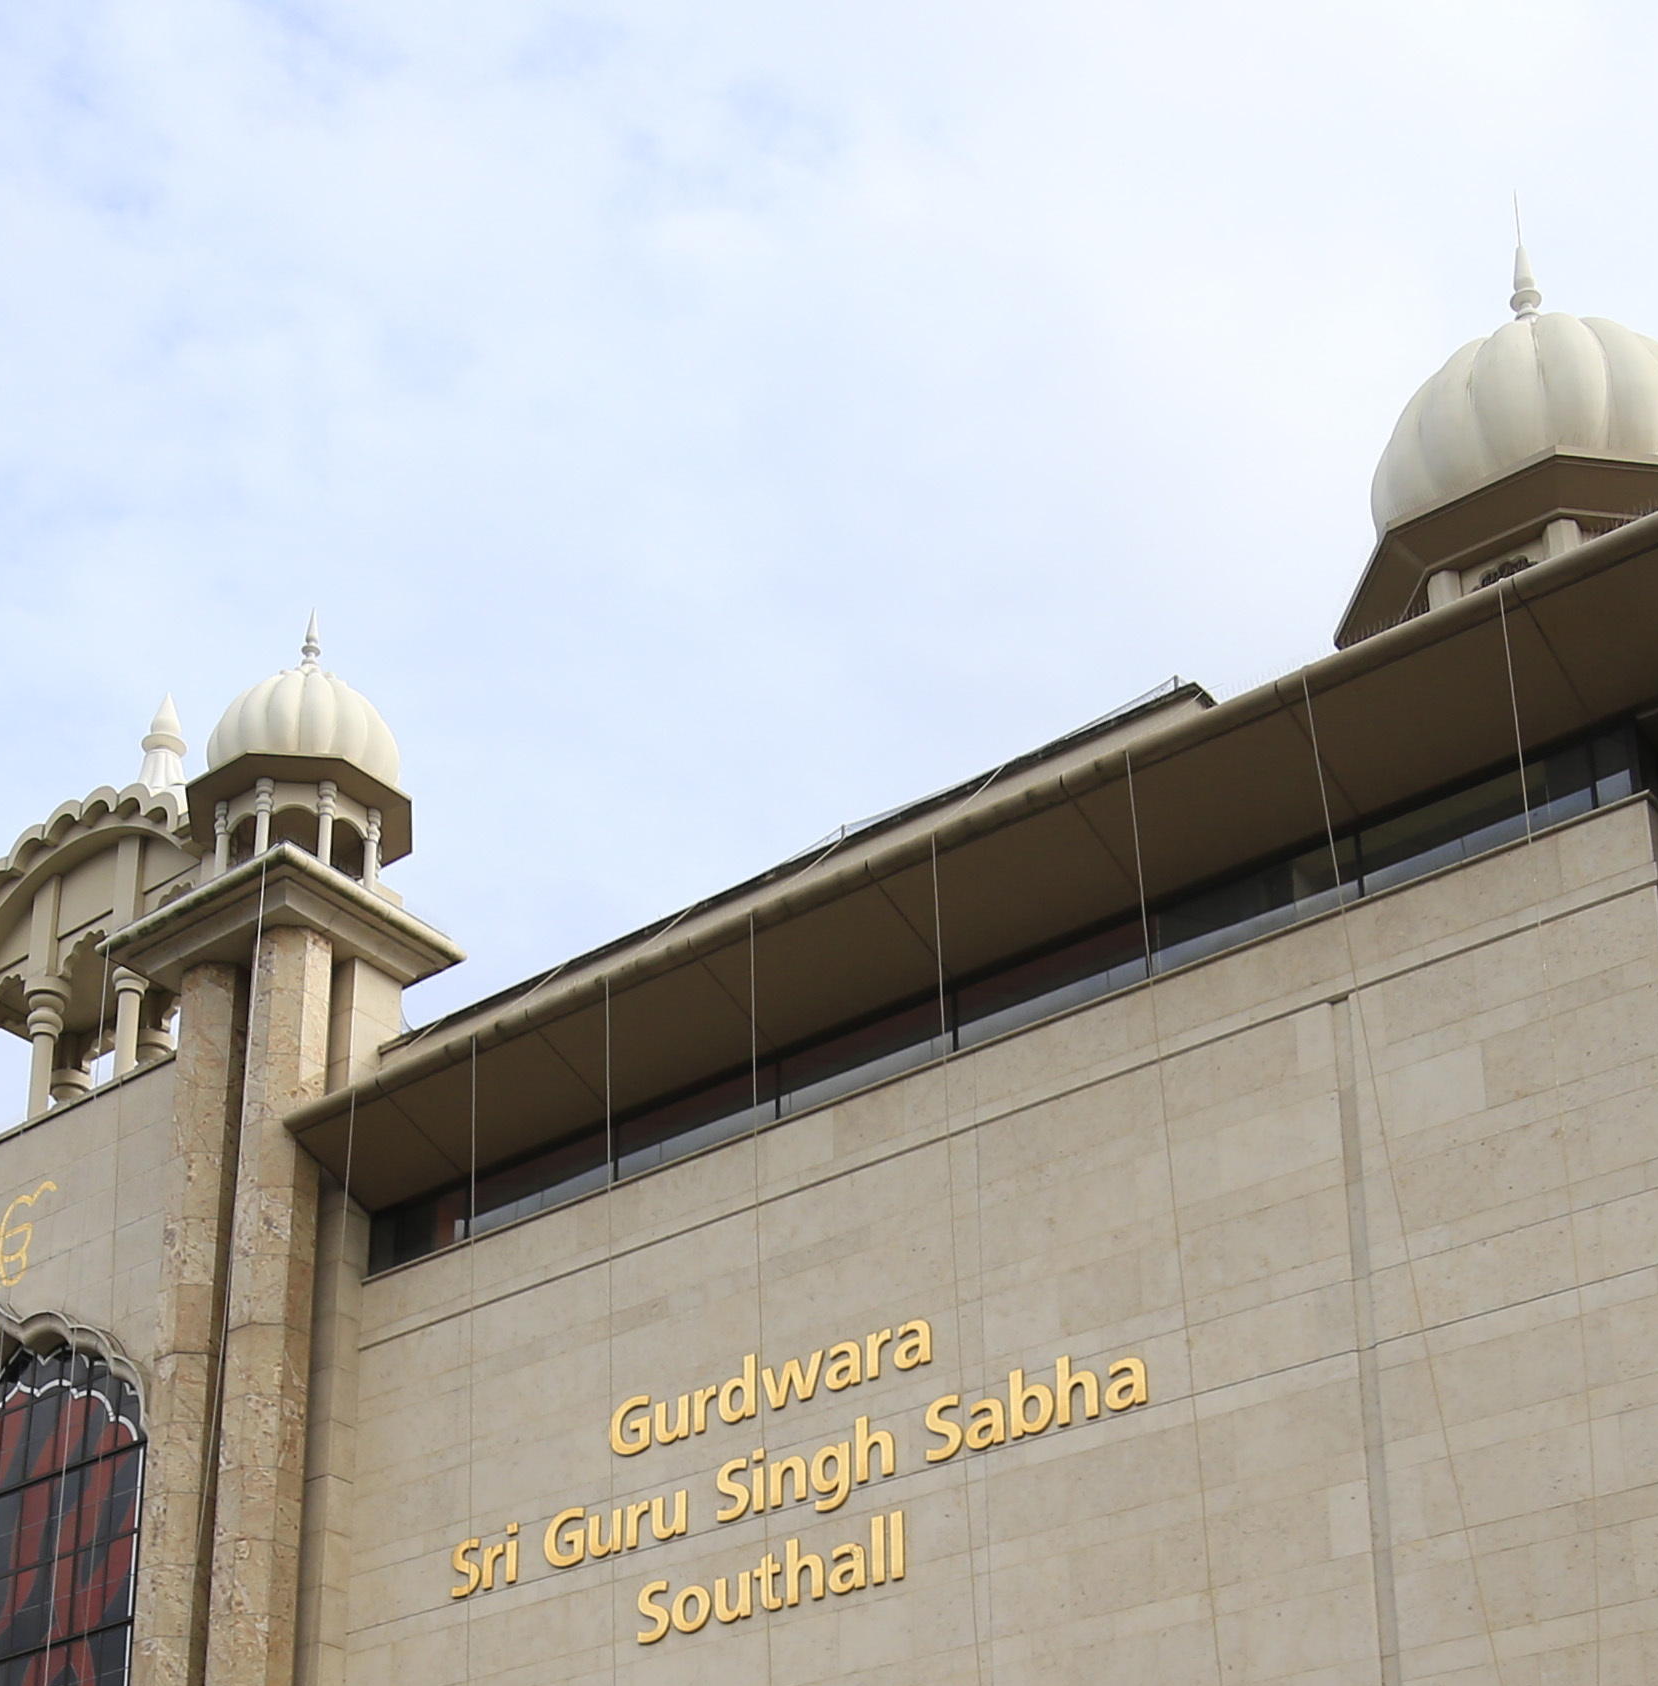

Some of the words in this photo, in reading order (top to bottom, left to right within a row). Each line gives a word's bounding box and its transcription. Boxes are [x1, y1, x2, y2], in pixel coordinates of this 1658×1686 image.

[609, 1319, 934, 1458] Gurdwara
[450, 1522, 520, 1600] Sri
[543, 1488, 689, 1569] Guru
[716, 1415, 897, 1524] Singh
[924, 1354, 1150, 1464] Sabha
[636, 1510, 906, 1646] Southall
